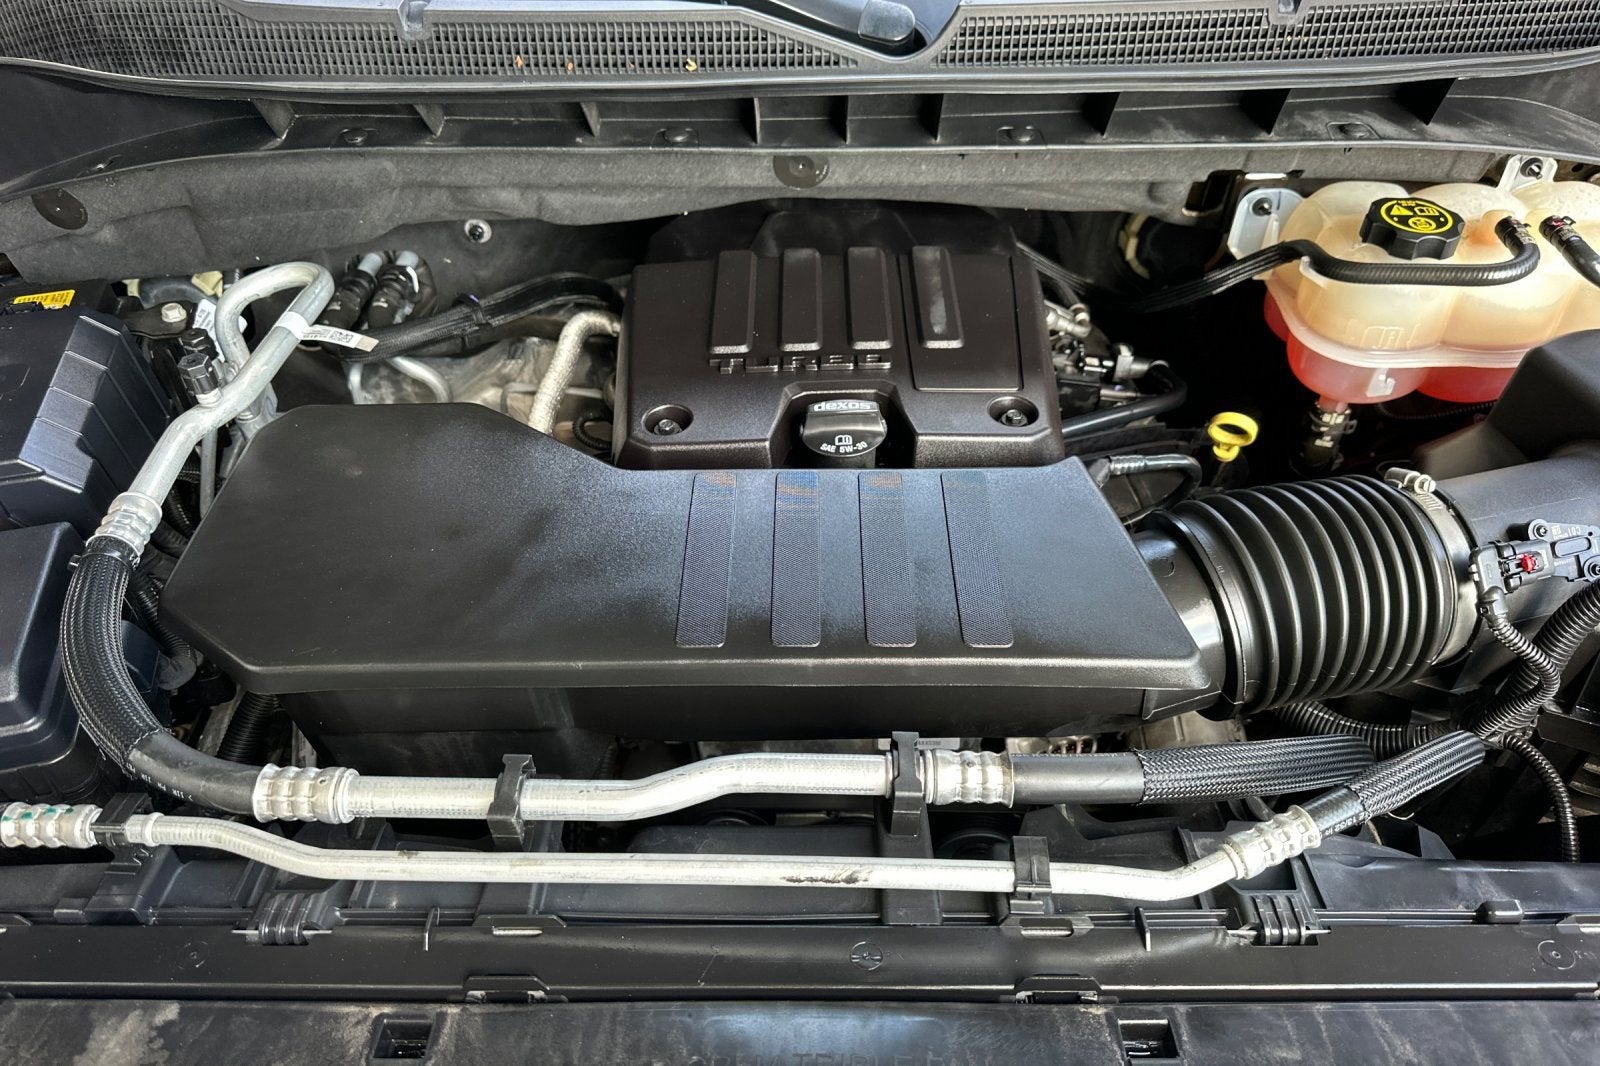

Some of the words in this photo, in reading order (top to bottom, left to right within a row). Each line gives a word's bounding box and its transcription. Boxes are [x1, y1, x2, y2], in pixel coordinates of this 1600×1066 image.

[813, 401, 871, 412] dexos
[820, 443, 837, 453] SAE
[839, 440, 868, 453] 5W-30
